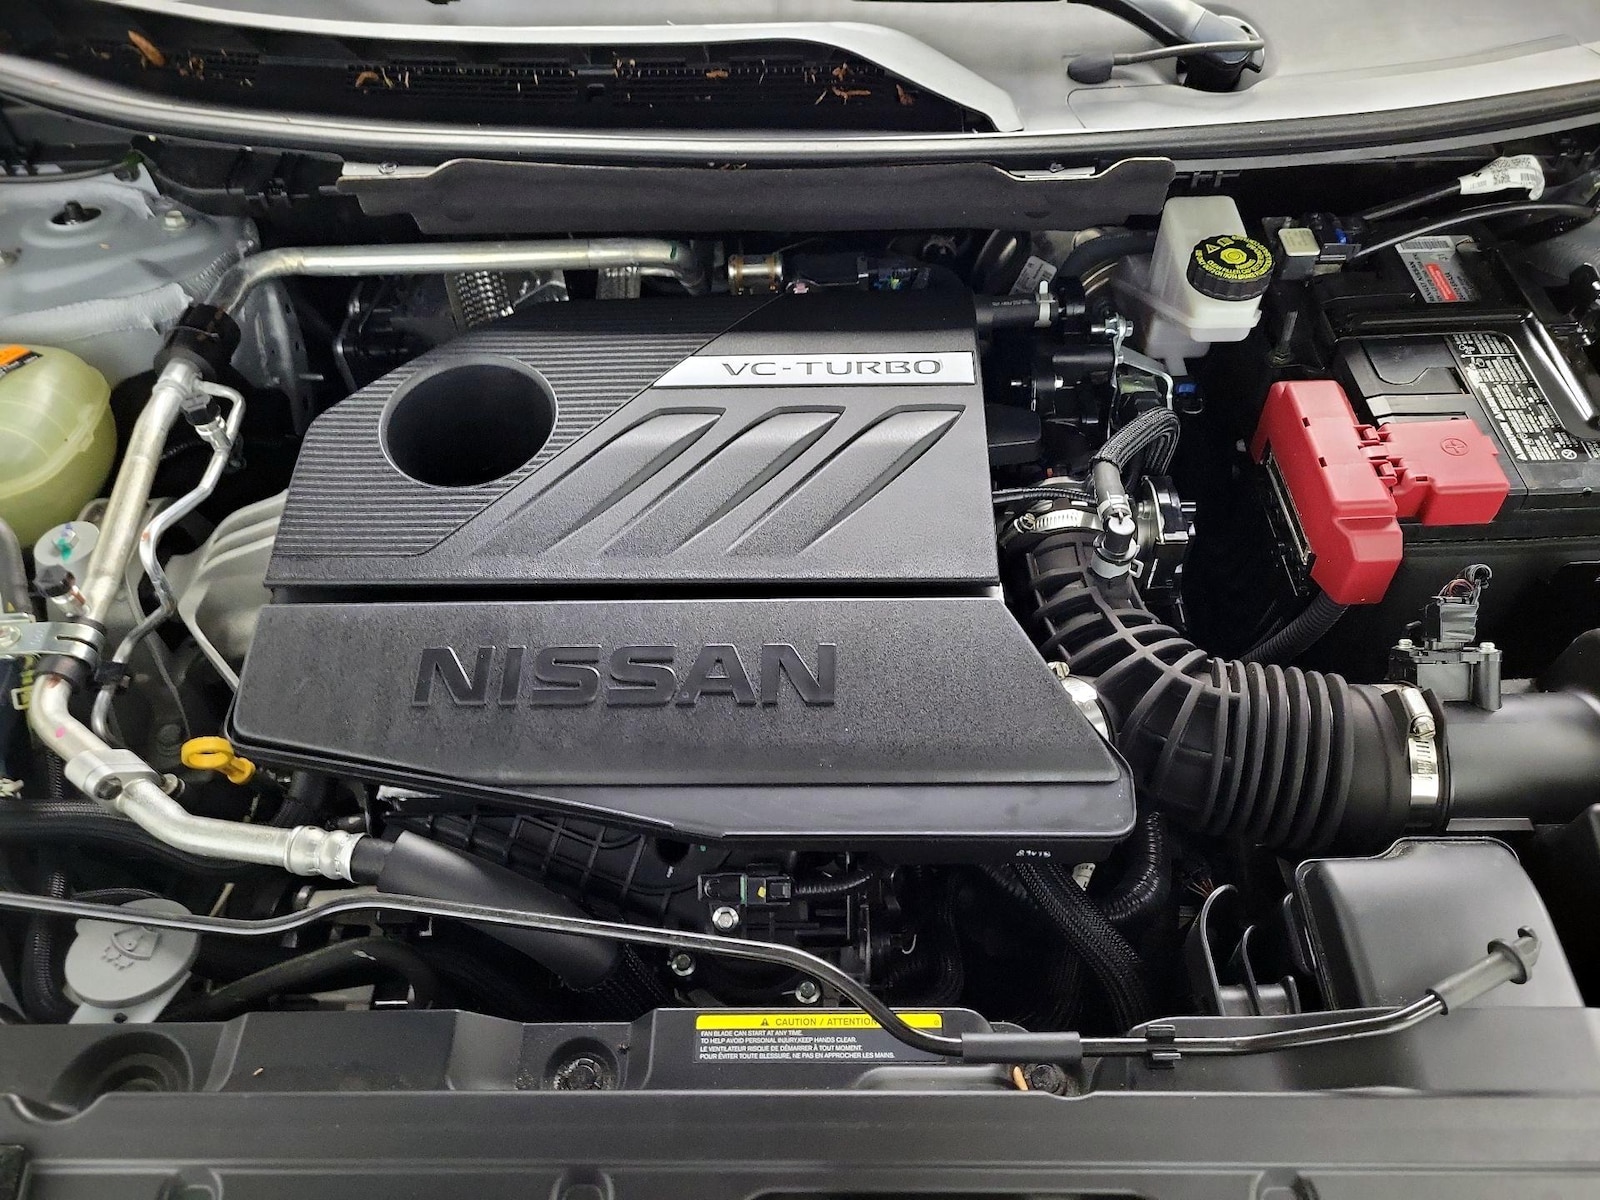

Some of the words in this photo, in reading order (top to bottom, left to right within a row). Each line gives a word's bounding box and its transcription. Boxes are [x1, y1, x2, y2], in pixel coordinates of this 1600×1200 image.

[722, 359, 942, 376] VC-TURBO
[411, 643, 838, 707] NISSAN
[775, 1018, 817, 1026] CAUTION
